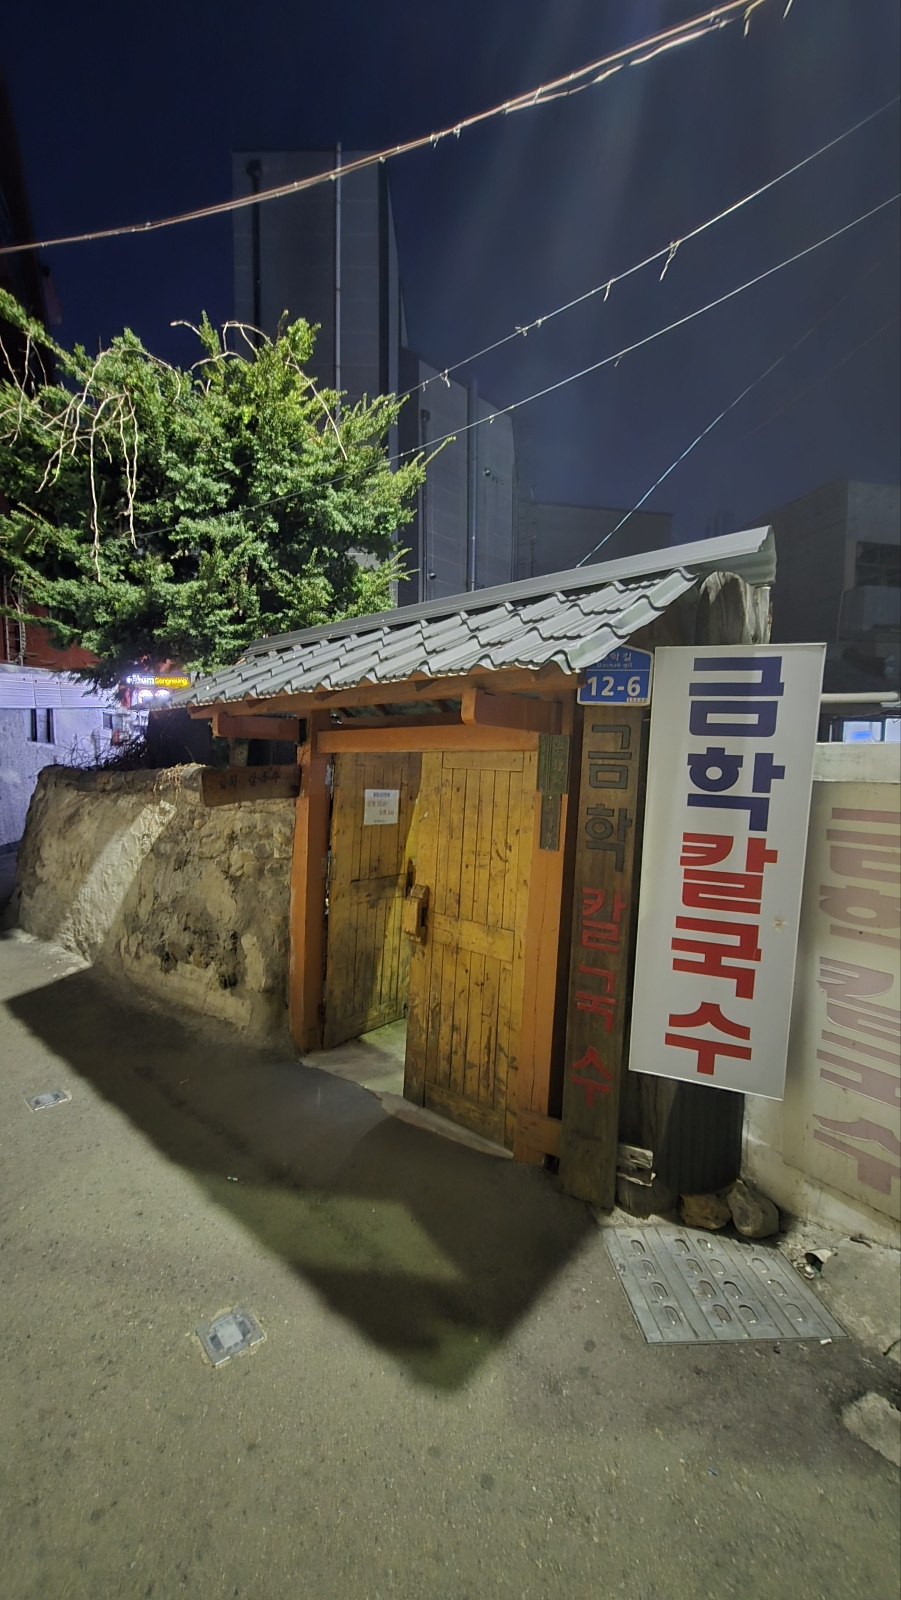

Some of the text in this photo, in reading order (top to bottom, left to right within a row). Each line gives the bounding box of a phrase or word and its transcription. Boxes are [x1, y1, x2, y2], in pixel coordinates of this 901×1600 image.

[587, 676, 641, 697] 12-6
[664, 656, 785, 1076] 금학칼국수
[570, 723, 632, 1108] 금학칼국수
